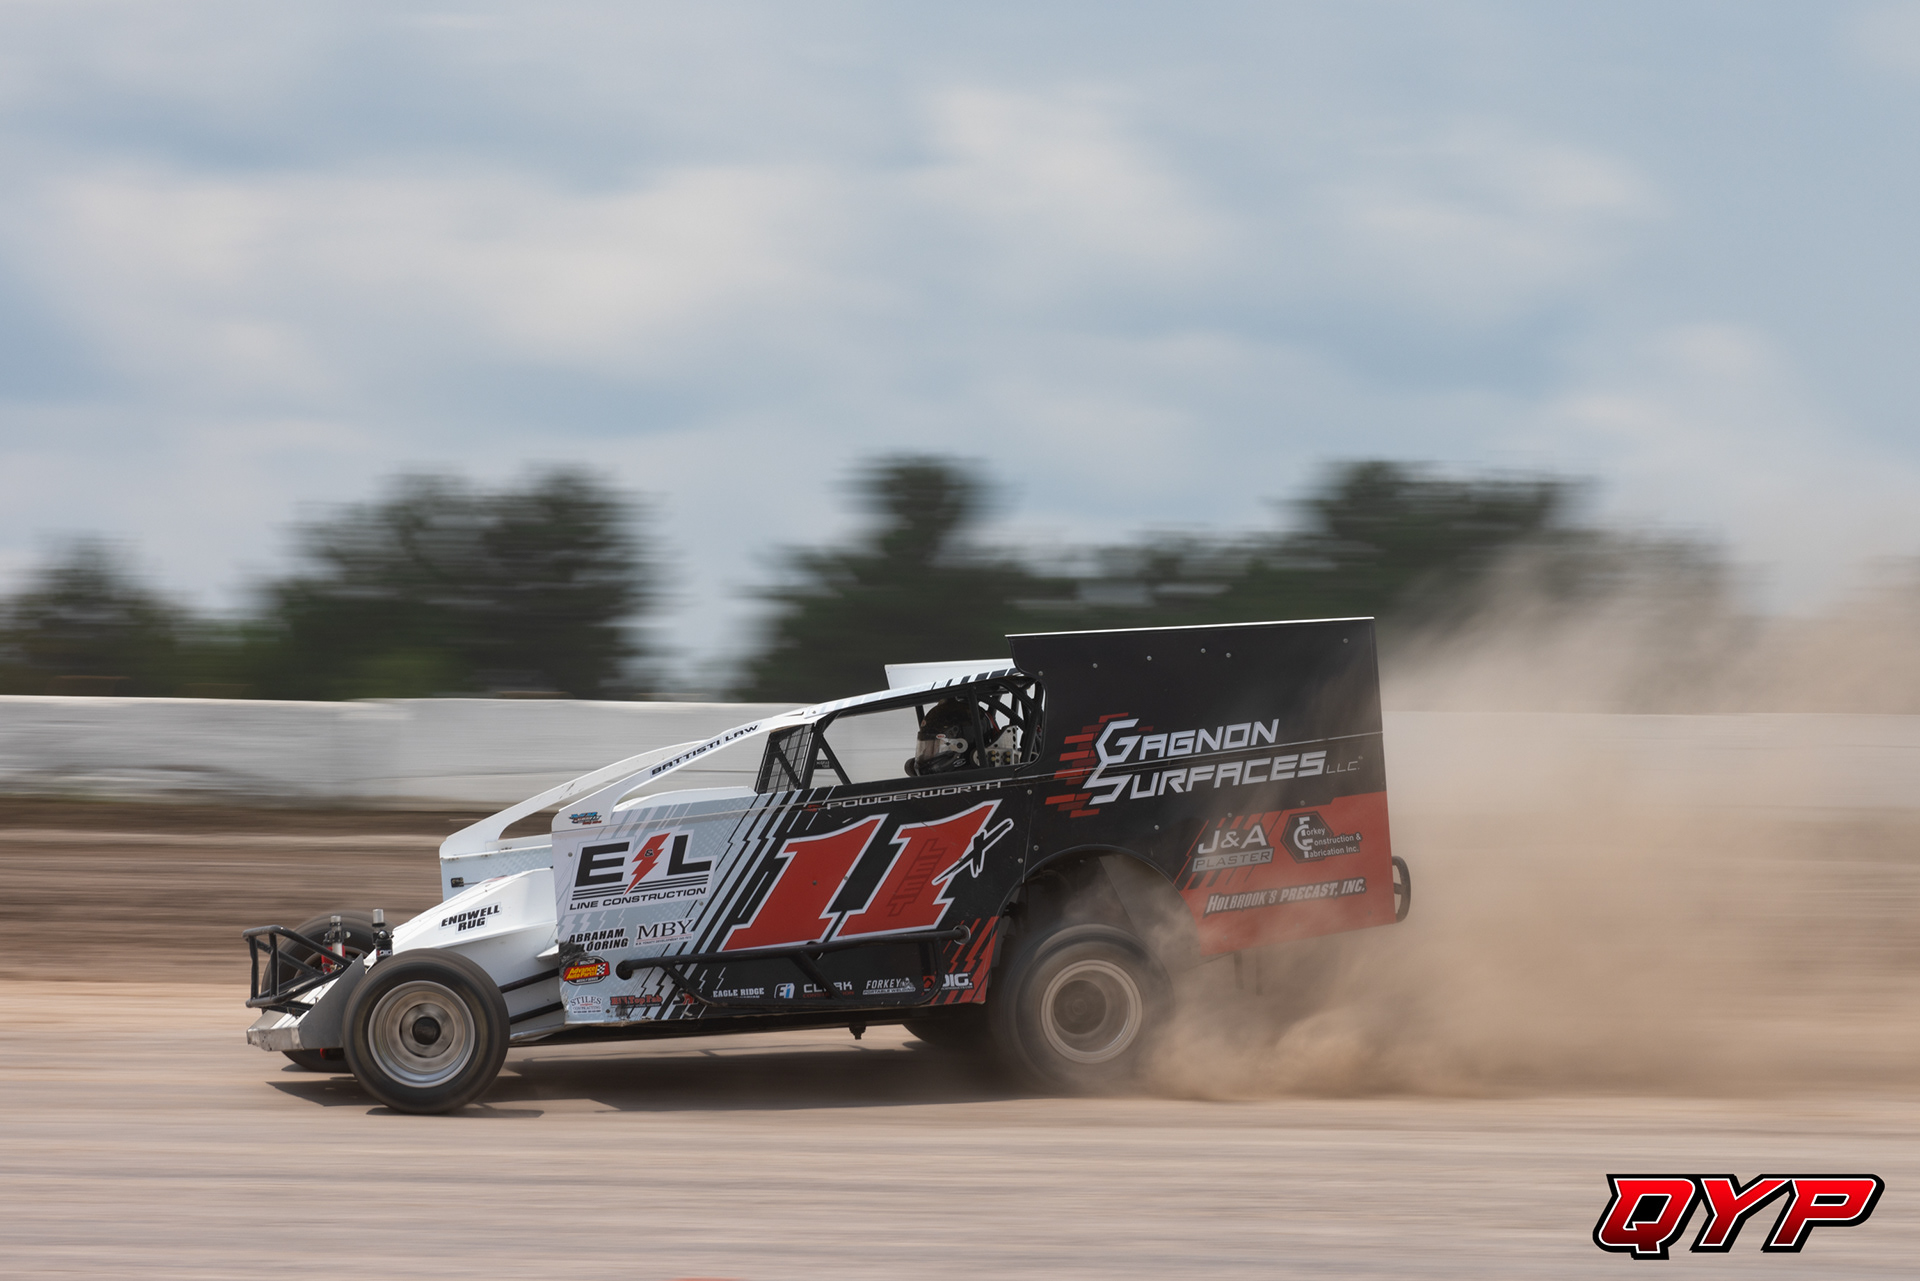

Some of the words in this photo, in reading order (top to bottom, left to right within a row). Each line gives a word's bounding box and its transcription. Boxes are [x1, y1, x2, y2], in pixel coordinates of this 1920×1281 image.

[651, 739, 721, 776] BATTISTI
[725, 724, 758, 742] LAW
[1095, 718, 1280, 765] GAGNON
[1082, 750, 1327, 806] SURFACES
[826, 781, 1001, 810] POWDERWORTH
[1195, 851, 1271, 871] PLASTER
[1340, 878, 1366, 895] INC.
[569, 900, 599, 911] LINE
[602, 887, 707, 907] CONSTRUCTION
[441, 904, 500, 928] ENDWELL
[457, 916, 486, 932] RUG
[569, 928, 625, 944] ABRAHAM
[638, 919, 694, 940] MBY
[581, 938, 629, 953] LOORING
[712, 989, 738, 998] EAGLE
[740, 987, 765, 996] RIDGE
[803, 981, 853, 993] CLRK
[865, 978, 901, 990] FORKEY
[570, 996, 602, 1006] STILES
